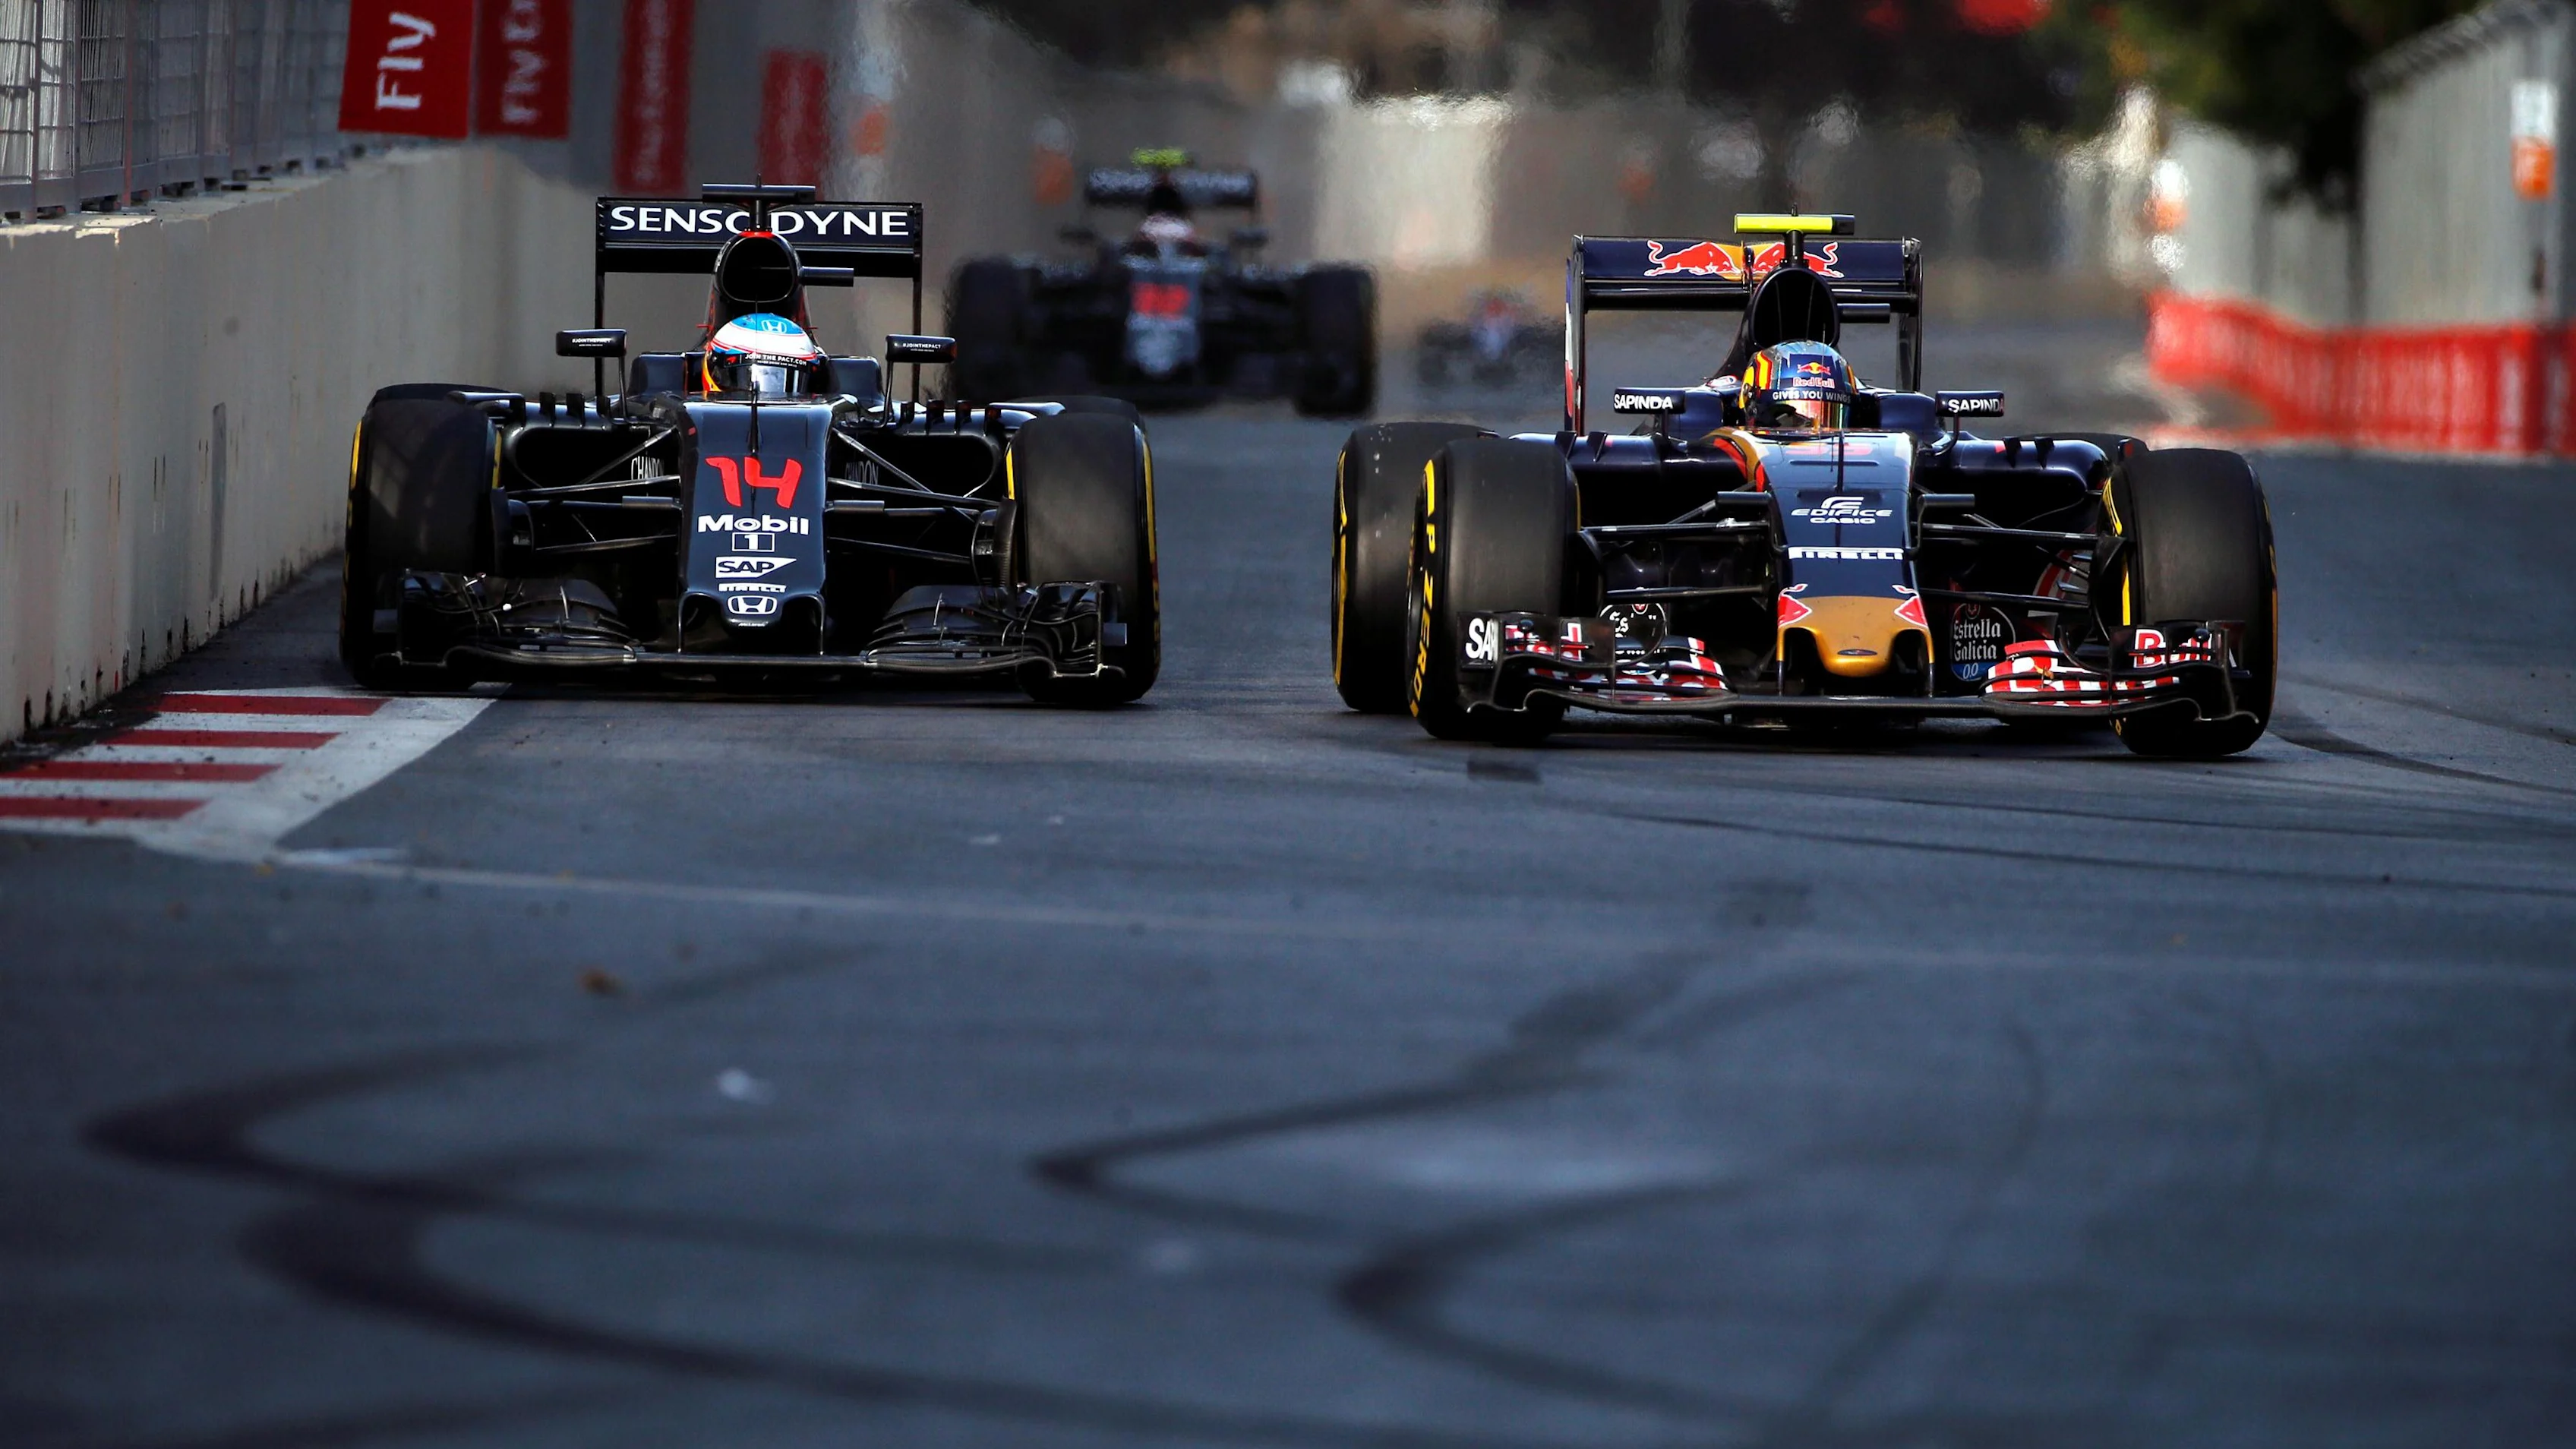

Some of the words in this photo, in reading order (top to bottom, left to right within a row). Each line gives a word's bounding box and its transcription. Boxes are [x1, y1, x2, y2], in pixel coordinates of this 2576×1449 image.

[375, 11, 437, 110] Fly
[1614, 393, 1674, 409] SAPINDA
[1773, 390, 1800, 401] GIVES
[1801, 390, 1823, 399] YOU
[705, 456, 803, 509] 14
[1791, 508, 1893, 517] EDIFICE
[697, 514, 810, 535] Mobil
[744, 533, 759, 551] 1
[1788, 546, 1905, 560] PIRELLI
[718, 560, 775, 573] SAP
[718, 582, 787, 592] PIRELLI
[1413, 570, 1433, 702] ZERO
[1953, 618, 2001, 639] Estrella
[1954, 639, 1997, 661] Galicia
[1962, 662, 1979, 679] 0.0
